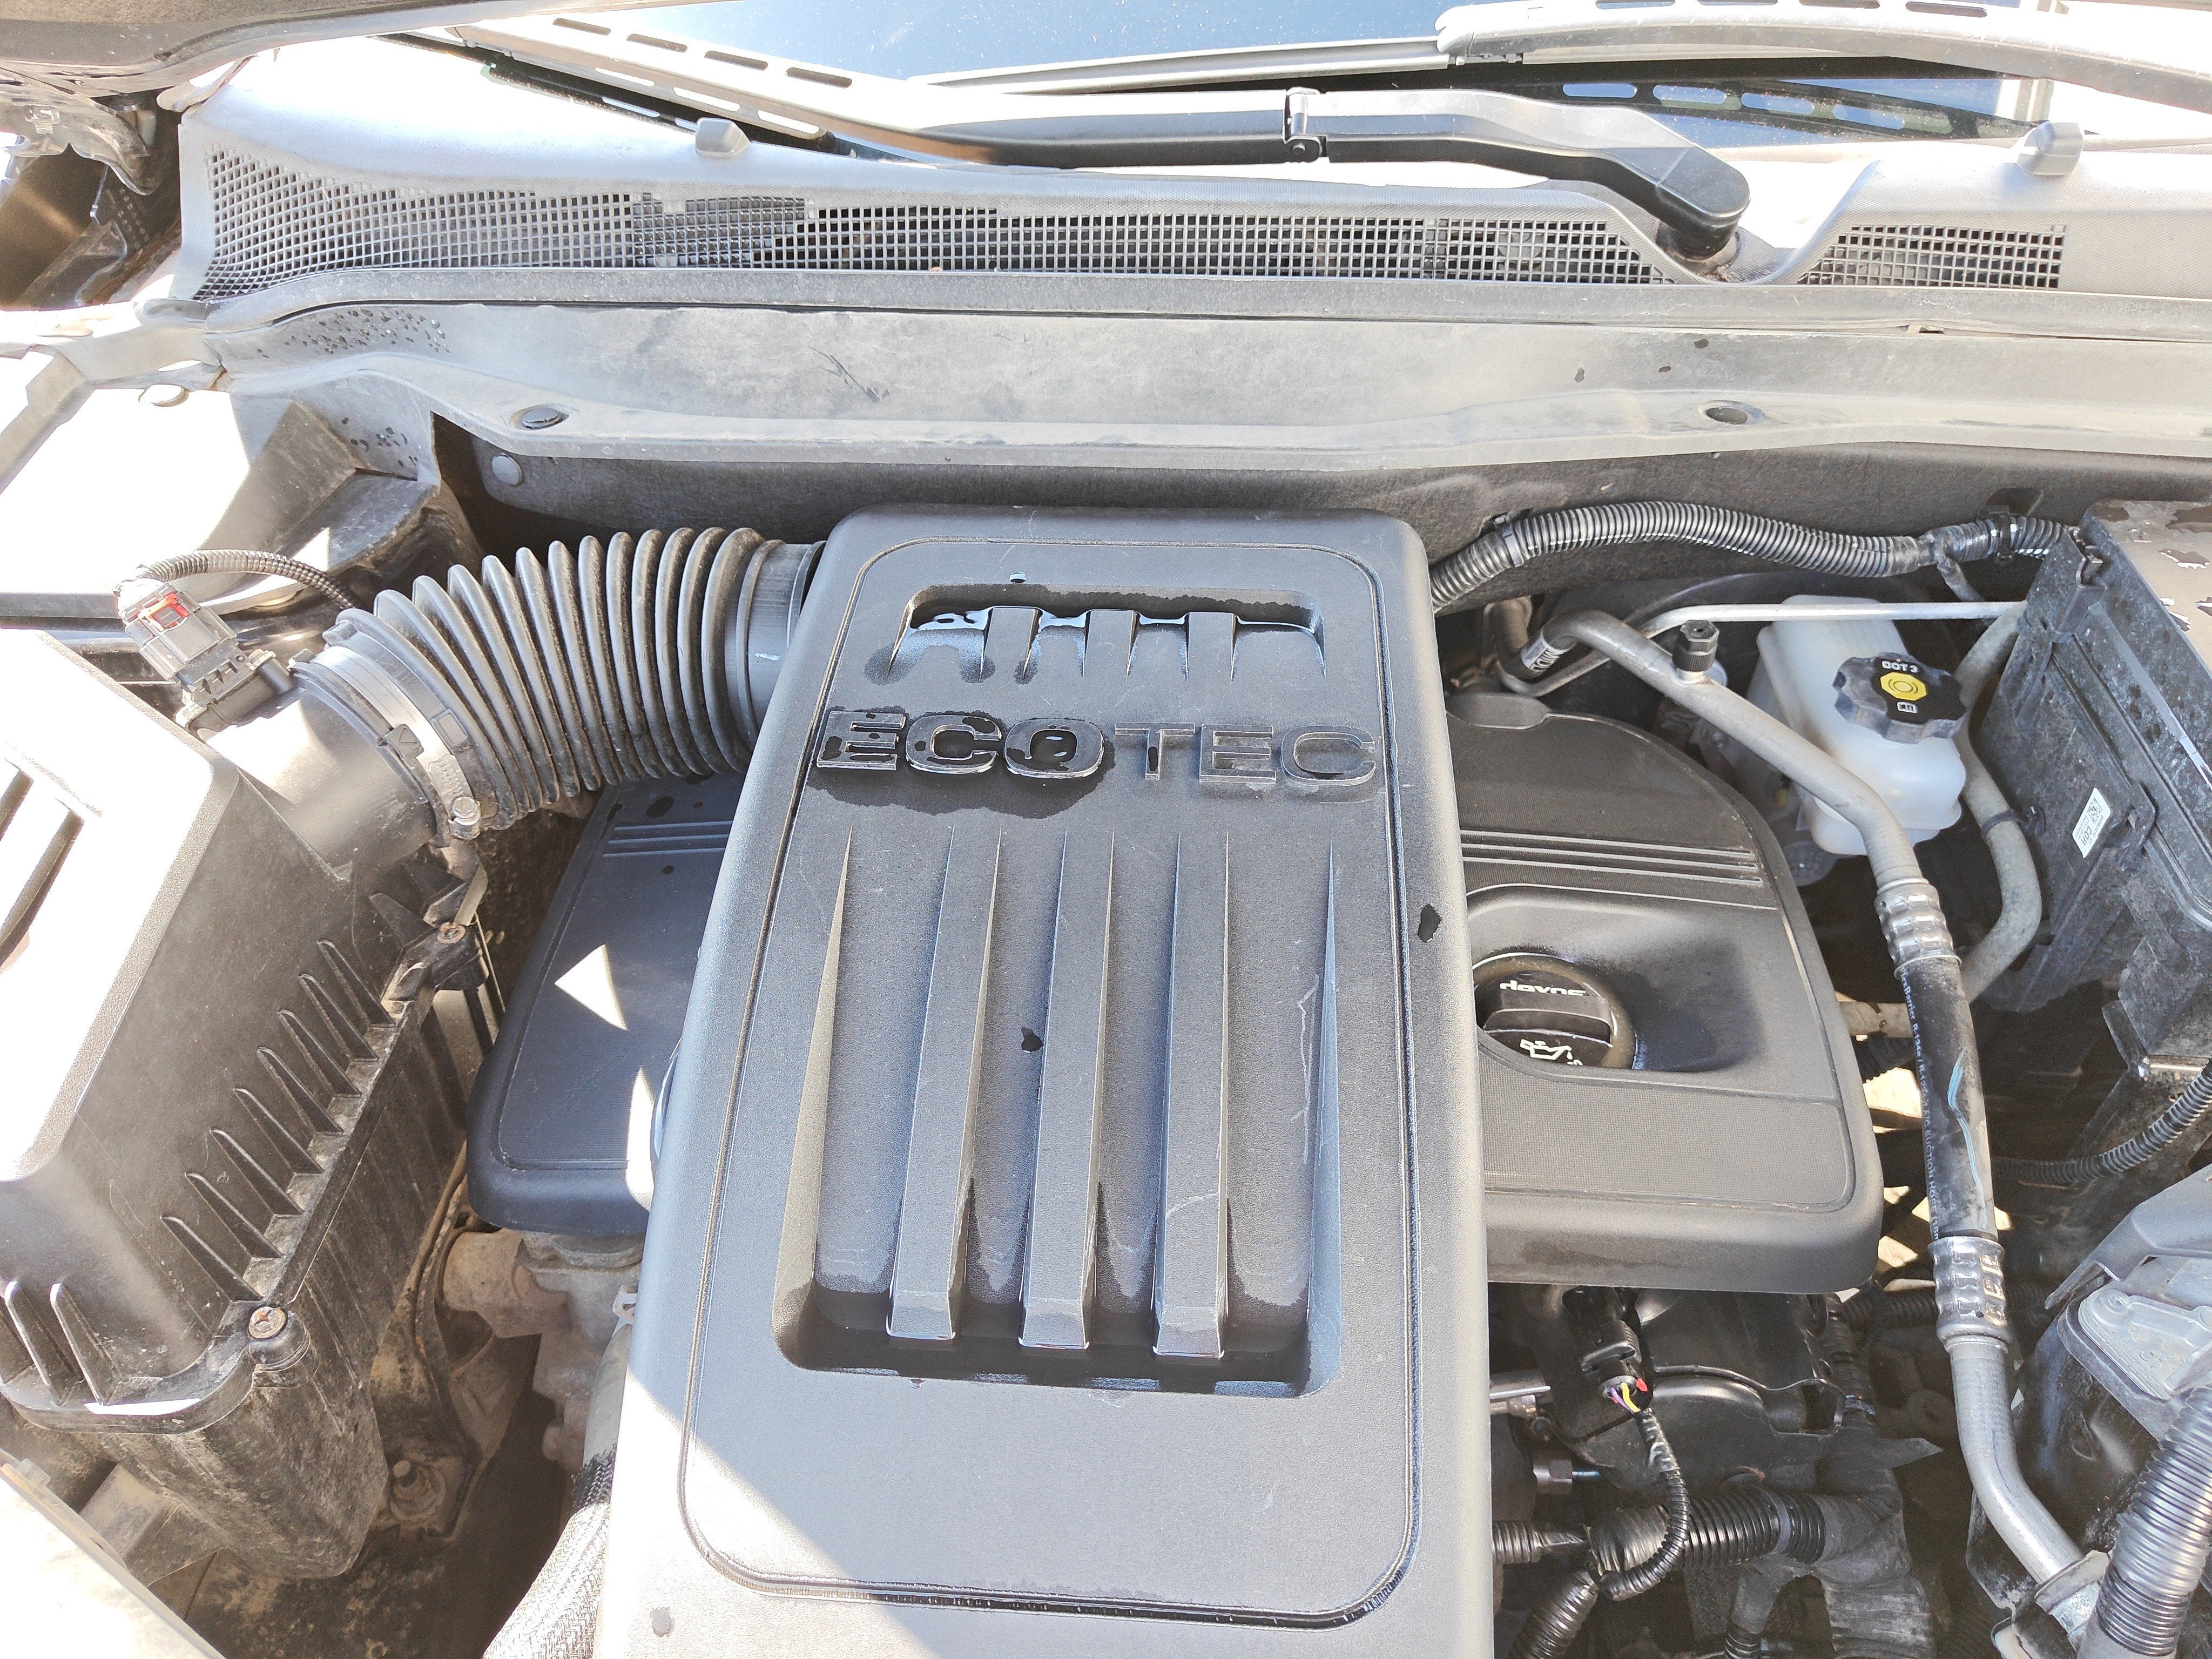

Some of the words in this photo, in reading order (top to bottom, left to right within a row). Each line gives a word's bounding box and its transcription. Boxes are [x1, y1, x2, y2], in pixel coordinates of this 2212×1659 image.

[1881, 660, 1908, 672] DOT
[1910, 664, 1919, 673] 3
[816, 710, 1377, 787] ECOTEC
[2081, 826, 2093, 846] COR
[1925, 1129, 1933, 1178] SUCTION
